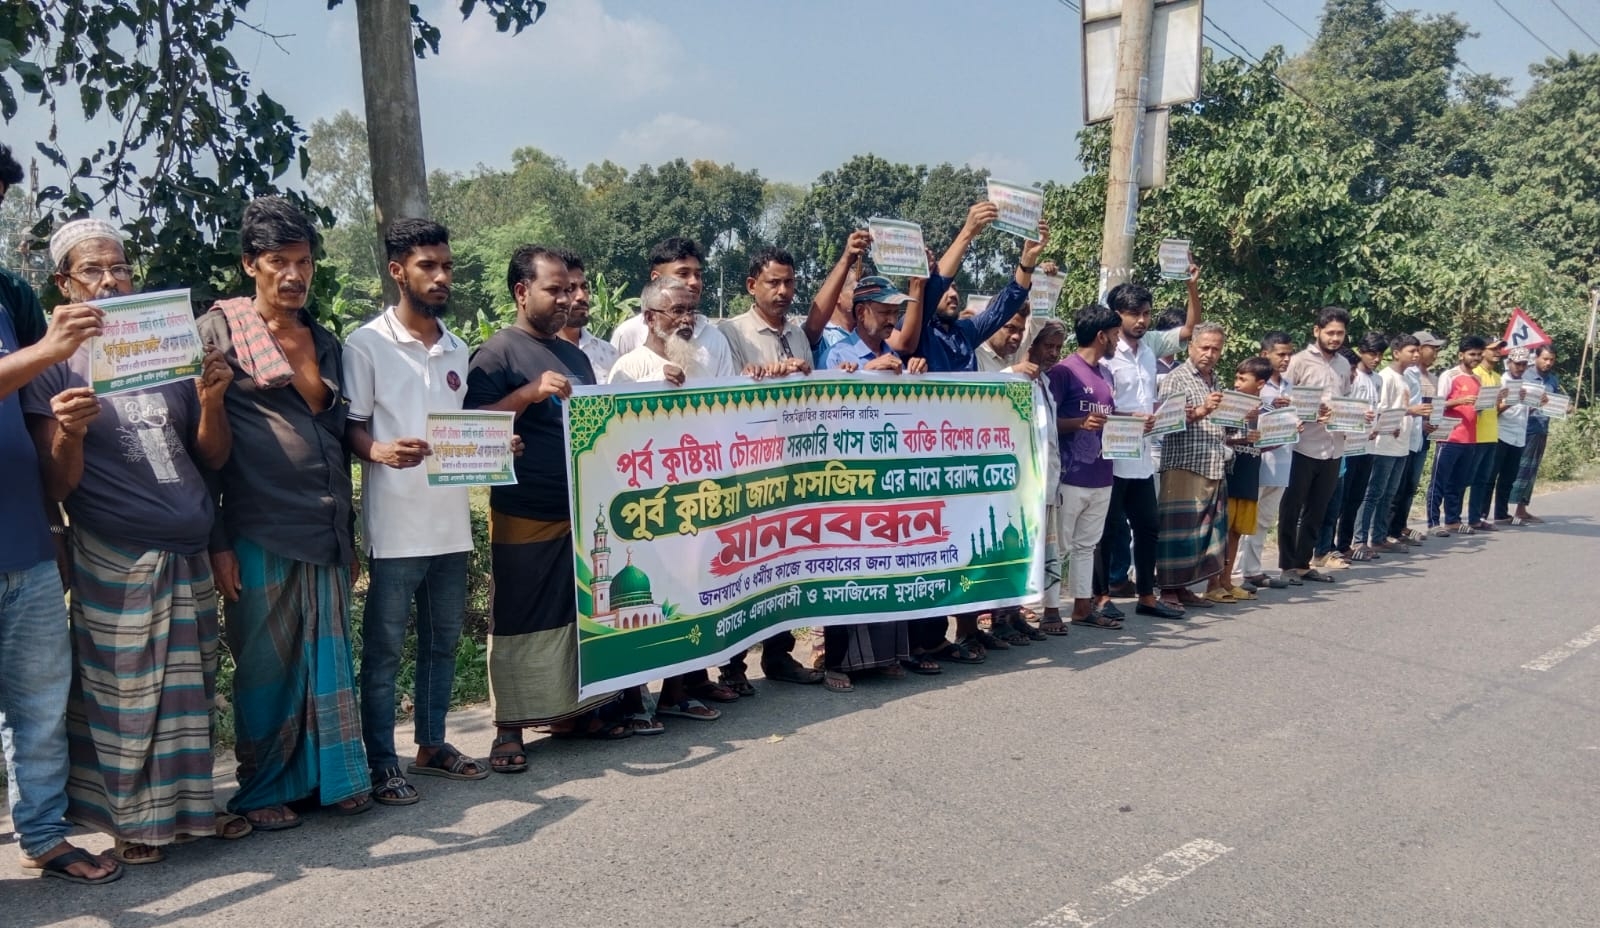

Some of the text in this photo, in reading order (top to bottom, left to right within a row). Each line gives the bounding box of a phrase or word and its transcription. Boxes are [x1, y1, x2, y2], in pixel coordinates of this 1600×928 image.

[819, 405, 856, 421] রাহমানির
[858, 405, 880, 420] রাহিম
[659, 433, 723, 483] কুষ্টিয়া
[729, 431, 786, 469] চৌরাস্তায়
[787, 423, 829, 458] সরকারি
[833, 427, 865, 455] খাস
[869, 422, 898, 454] জমি
[902, 420, 937, 453] ব্যক্তি
[941, 421, 974, 452] বিশেষ
[977, 427, 992, 450] কে
[993, 425, 1016, 452] নয়,
[673, 479, 742, 535] কুষ্টিয়া
[746, 475, 789, 509] জামে
[793, 460, 877, 499] মসজিদ
[881, 468, 905, 492] এর
[908, 466, 940, 492] নামে
[944, 463, 979, 490] বরাদ্দ
[983, 462, 1017, 486] চেয়ে
[715, 500, 946, 564] মানববন্ধন
[698, 544, 959, 606] জনস্বার্থে ও ধর্মীয় কাজে ব্যবহারের জন্য আমাদের দাবি
[715, 608, 747, 638] প্রচারে:
[749, 585, 802, 620] এলাকাবাসী
[806, 588, 818, 604] ও
[822, 580, 889, 603] মসজিদের
